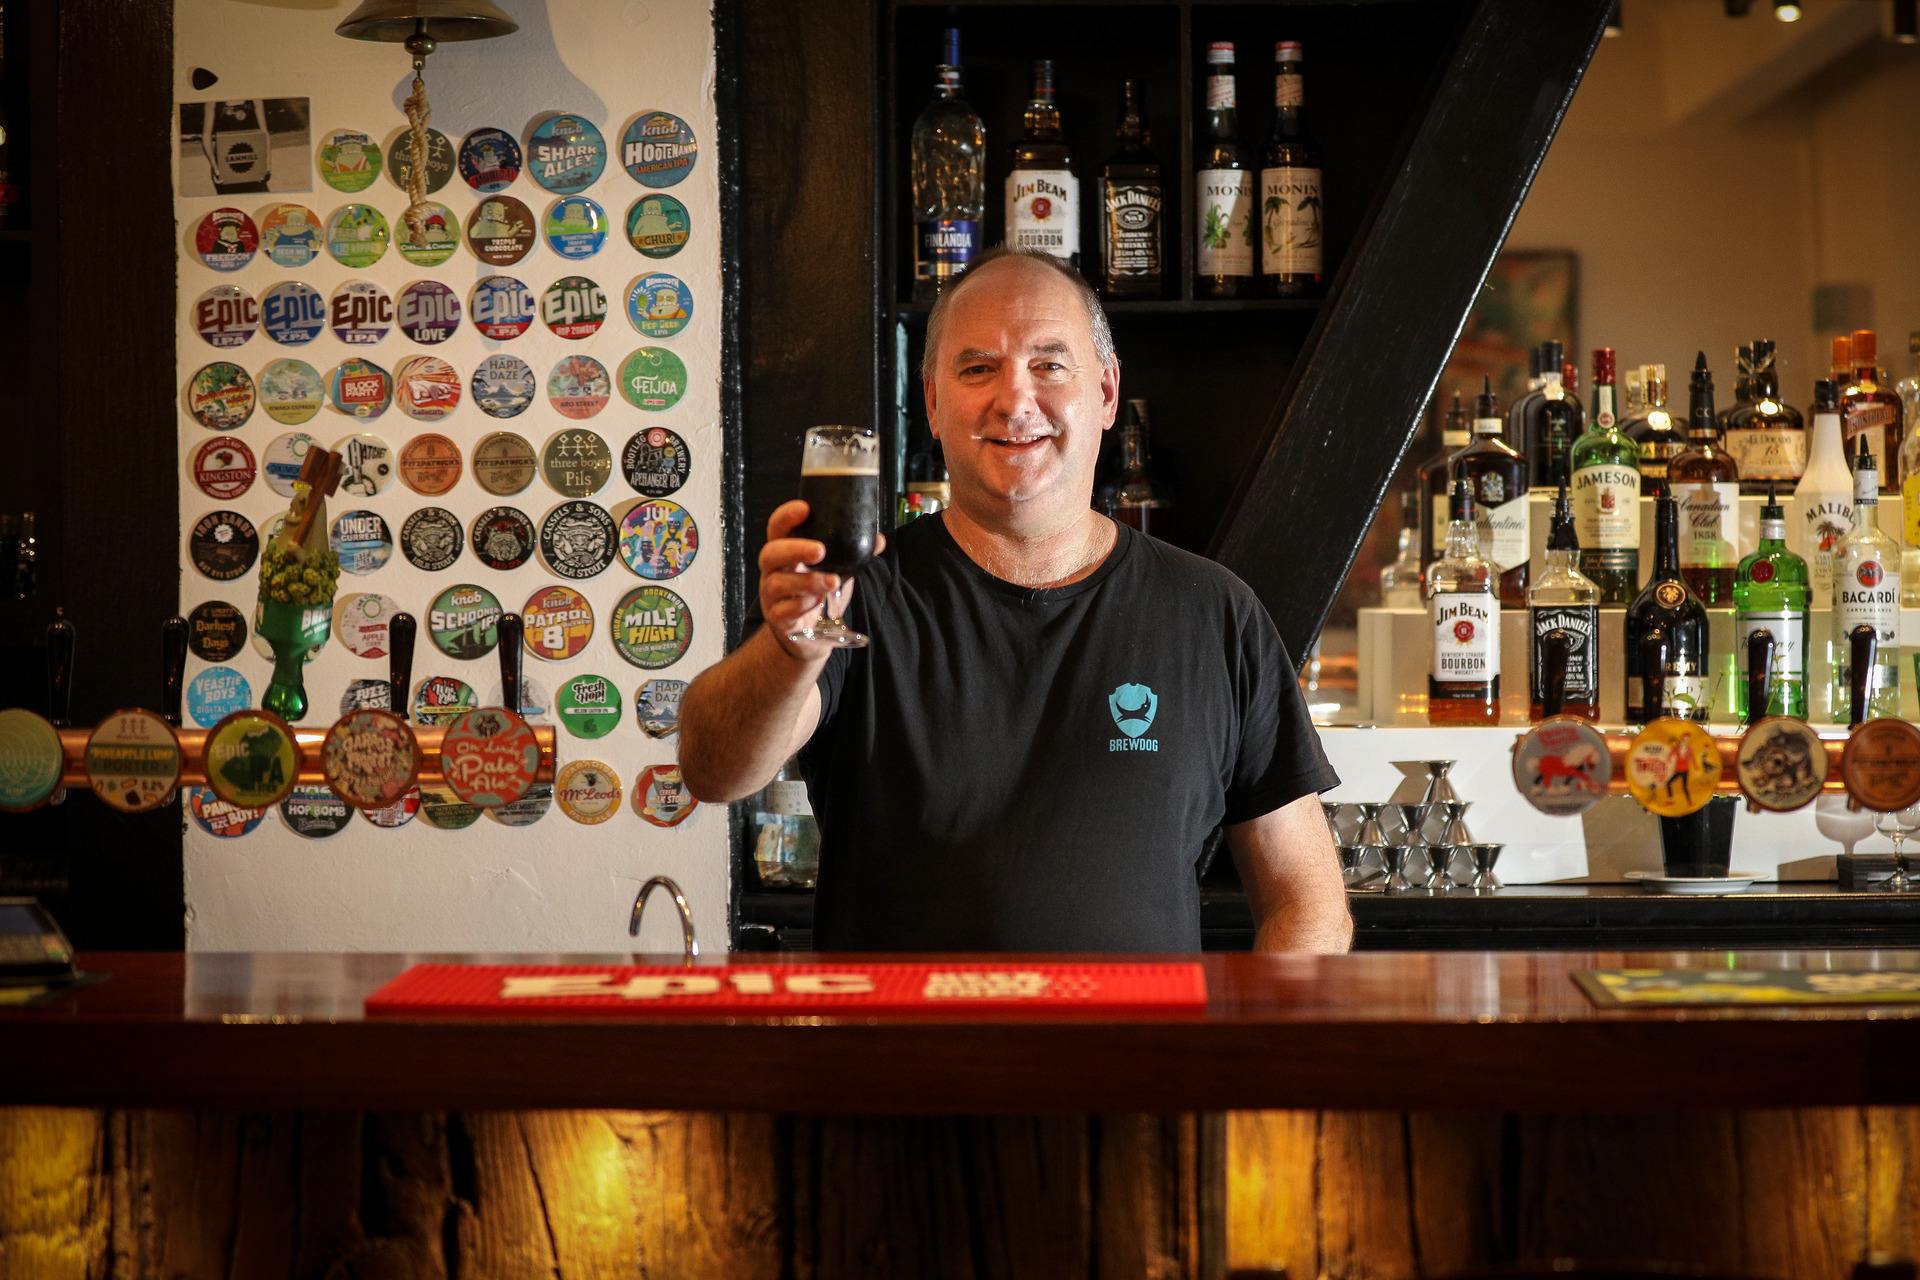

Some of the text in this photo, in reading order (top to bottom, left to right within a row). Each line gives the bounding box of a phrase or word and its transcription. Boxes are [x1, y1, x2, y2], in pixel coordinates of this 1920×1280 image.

[641, 121, 679, 137] knob
[224, 152, 258, 164] SAWMILL
[538, 145, 597, 163] SHARK
[543, 154, 593, 178] ALLEY
[635, 158, 689, 175] AMERICAN IPA
[1013, 179, 1067, 203] JIM BEAM
[1267, 185, 1318, 196] MONIN
[1106, 194, 1128, 213] JACK
[924, 233, 972, 248] FINLANDIA
[1018, 234, 1063, 246] BOURBON
[484, 244, 524, 252] CHOCOLATE
[206, 253, 250, 262] FREEDOM
[646, 278, 679, 289] BEHEMOTH
[414, 328, 446, 341] LOVE
[556, 327, 570, 336] HOP
[489, 370, 518, 380] DAZE
[345, 380, 380, 391] BLOCK
[345, 388, 378, 397] PARTY
[626, 435, 687, 474] BOOTLEG BREWERY
[551, 457, 606, 468] three boys
[200, 470, 251, 482] KINGSTON
[565, 472, 591, 486] Pils
[630, 473, 681, 488] APEHANGER IPA
[1577, 471, 1637, 490] JAMESON
[1679, 496, 1730, 513] Canadian
[543, 503, 611, 540] CASSELS & SONS
[643, 507, 673, 521] JUL
[194, 513, 255, 538] IRON SANDS
[340, 517, 382, 534] UNDER
[402, 512, 423, 540] CASSELS
[474, 512, 494, 541] CASSELS
[509, 510, 528, 525] SONS
[341, 533, 382, 541] CURRENT
[1694, 531, 1717, 541] 1858
[431, 554, 456, 570] STOUT
[491, 559, 523, 570] RED IPA
[552, 559, 606, 577] MILK STOUT
[225, 563, 247, 578] STOUT
[451, 591, 482, 607] knob
[543, 595, 573, 609] knob
[1842, 588, 1895, 604] BACARDÍ
[431, 607, 501, 631] SCHOONER
[524, 609, 592, 629] PATROL
[625, 606, 677, 627] MILE
[1436, 602, 1488, 626] JIM BEAM
[195, 620, 236, 632] Darkest
[614, 608, 625, 640] WIGRAM
[1536, 614, 1593, 637] JACK DANIEL'S
[202, 637, 230, 650] Days
[362, 633, 385, 641] APPLE
[543, 625, 565, 650] 8
[629, 627, 675, 645] HIGH
[1442, 658, 1486, 669] BOURBON
[196, 676, 242, 695] YEASTIE
[355, 685, 386, 699] FUZZ
[573, 678, 606, 693] Fresh
[205, 687, 236, 703] BOYS
[576, 691, 606, 703] Hop!
[197, 705, 227, 714] DIGITAL
[361, 699, 390, 710] BOX
[1109, 738, 1159, 752] BREWDOG
[455, 754, 518, 782] Pale
[566, 760, 614, 778] PARADISE
[470, 774, 507, 791] Ale
[560, 787, 620, 801] McLeod's
[228, 809, 260, 826] BUY!
[289, 805, 346, 817] HOP BOMB
[569, 810, 612, 824] PALE ALE
